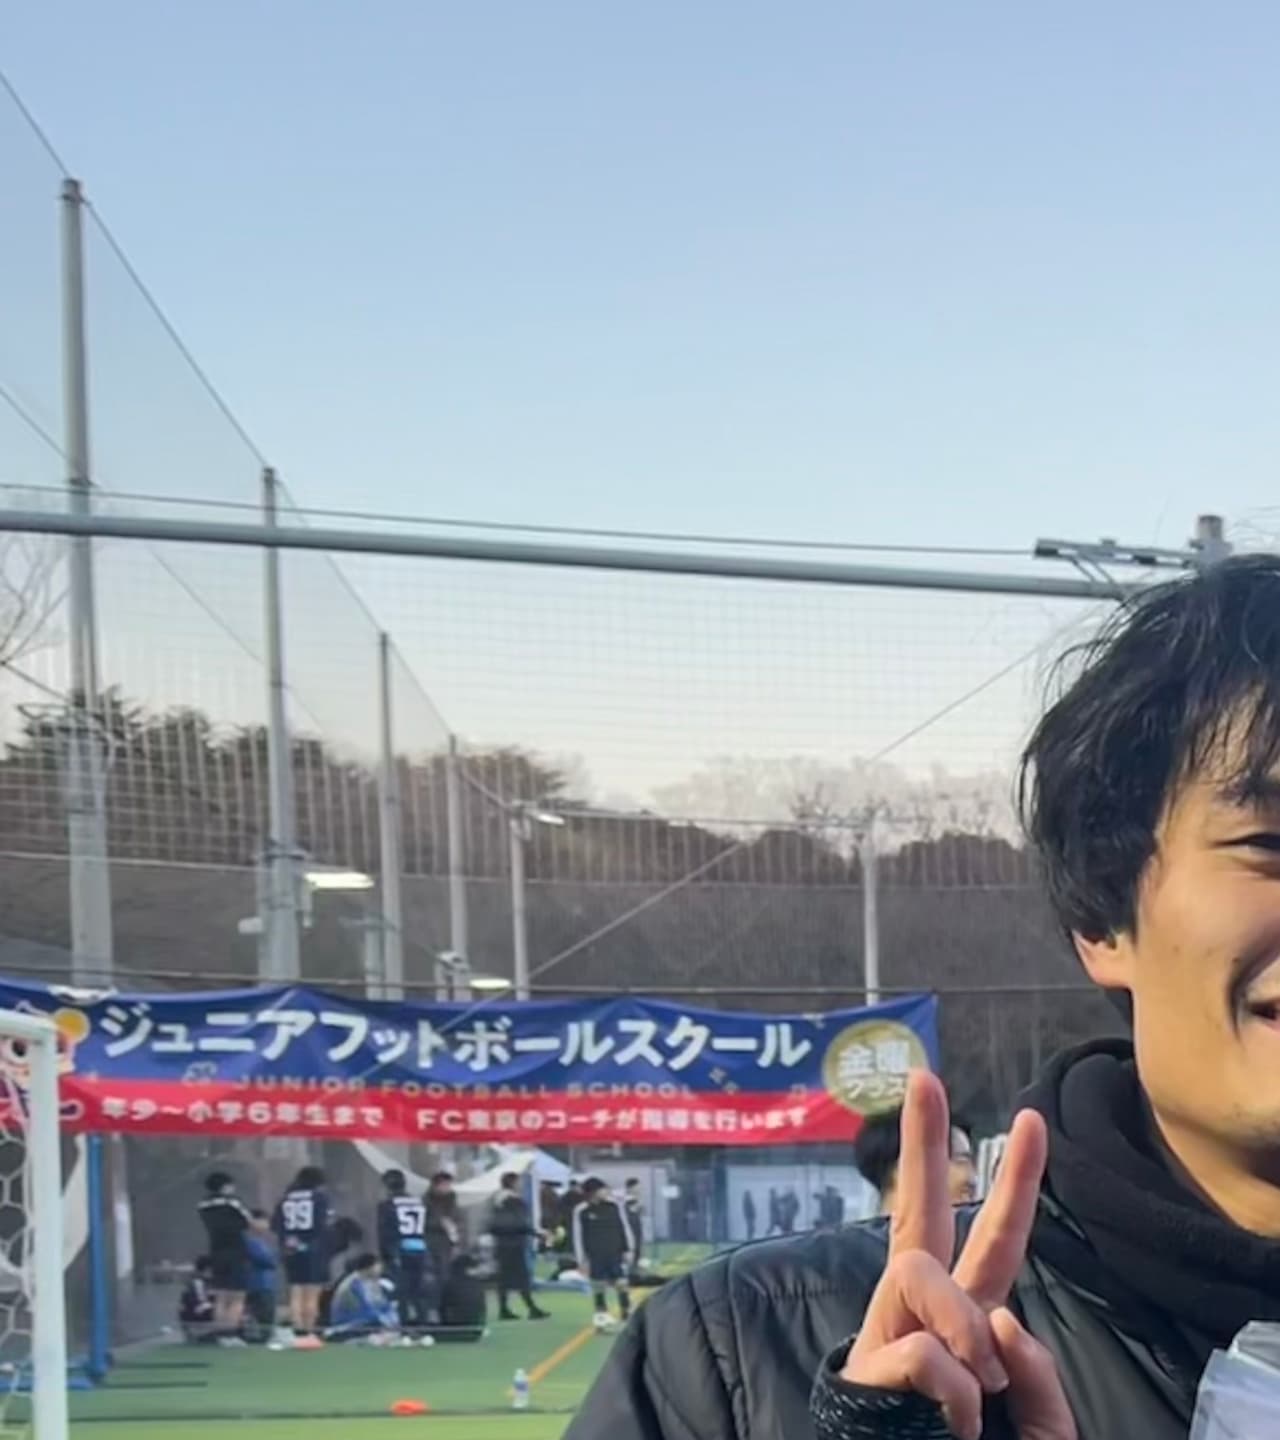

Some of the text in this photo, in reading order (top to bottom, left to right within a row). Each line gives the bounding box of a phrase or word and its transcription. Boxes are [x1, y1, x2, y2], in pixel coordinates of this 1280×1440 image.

[99, 1002, 812, 1072] ジュニアフットボールスクール
[232, 1074, 698, 1100] JUNIOR FOOTBALL SCHOOL
[282, 1200, 314, 1231] 99
[396, 1204, 427, 1235] 57
